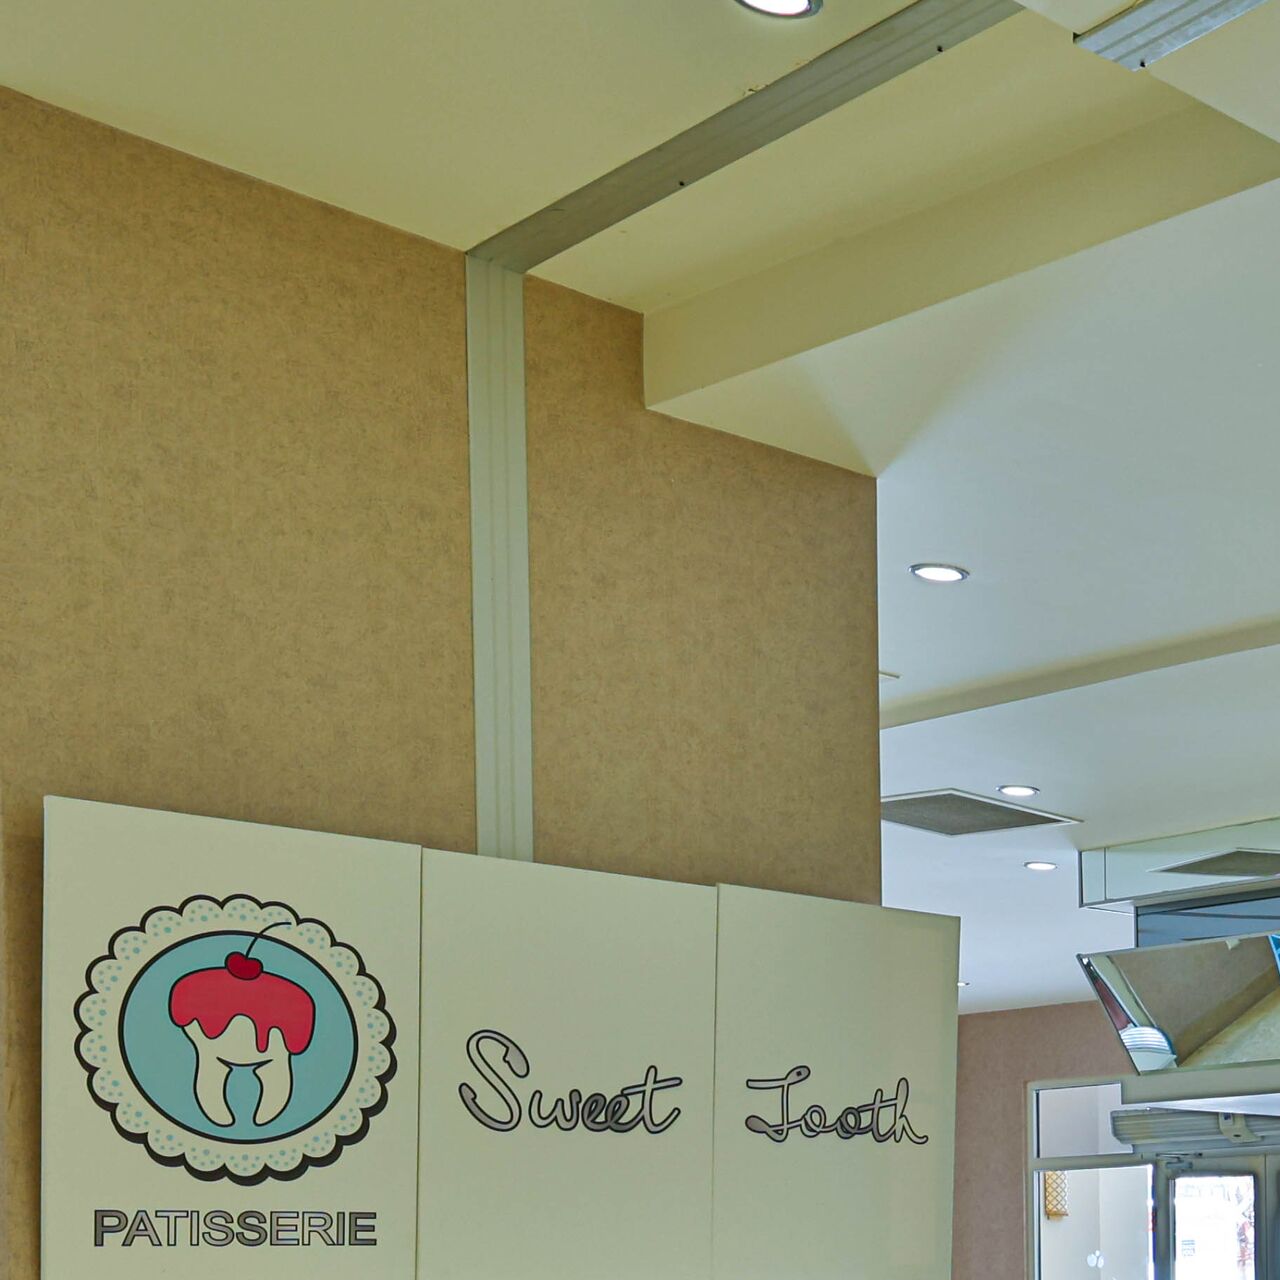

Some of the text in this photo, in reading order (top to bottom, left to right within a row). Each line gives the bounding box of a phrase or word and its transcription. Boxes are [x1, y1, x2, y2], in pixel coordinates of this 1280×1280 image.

[458, 1028, 929, 1144] Sweet Tooth
[94, 1209, 377, 1247] PATISSERIE
